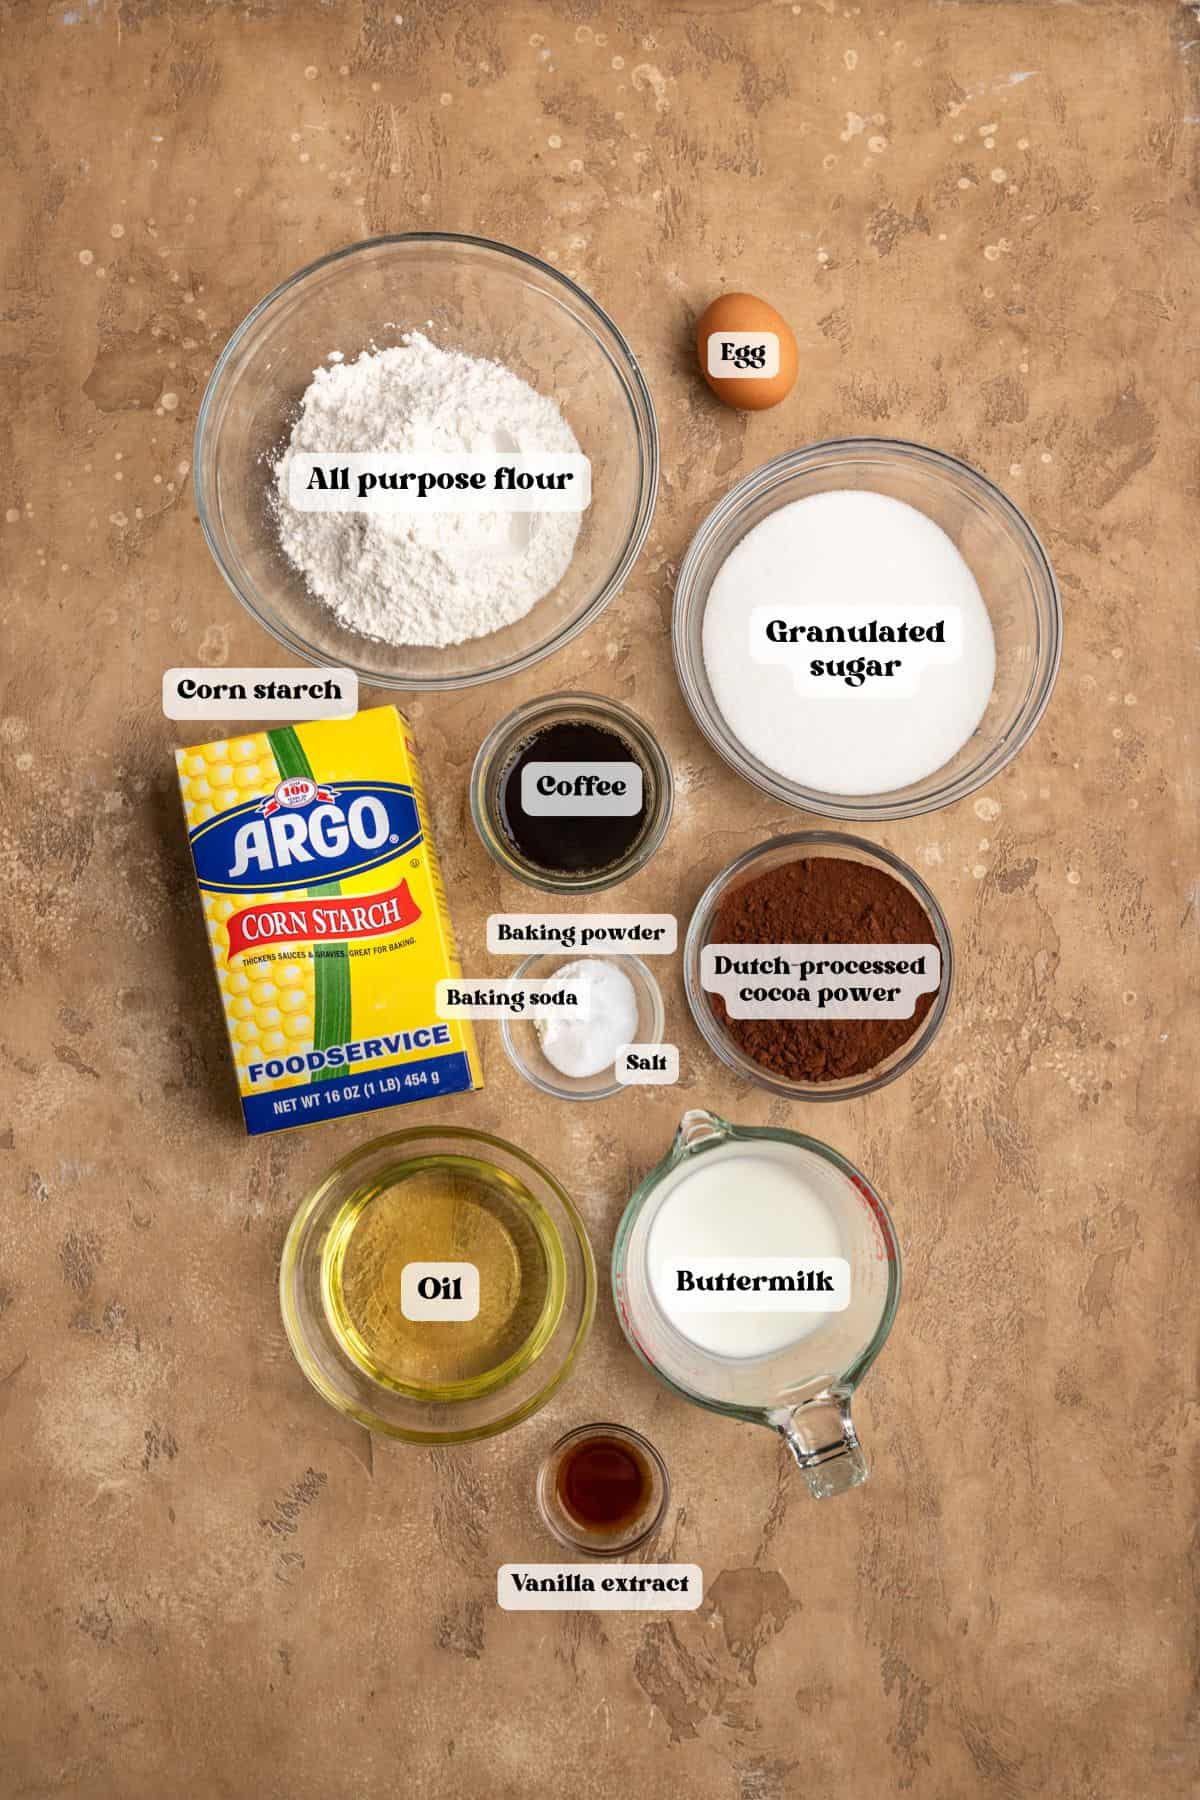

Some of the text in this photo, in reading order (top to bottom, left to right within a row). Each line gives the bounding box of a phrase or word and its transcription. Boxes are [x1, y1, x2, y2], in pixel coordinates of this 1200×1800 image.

[283, 783, 309, 797] 100
[228, 796, 390, 878] ARGO
[241, 909, 308, 941] CORN
[312, 898, 401, 934] STARCH
[278, 951, 306, 961] SAUCES
[374, 945, 387, 955] FOR
[248, 1024, 451, 1083] FOODSERVICE
[273, 1071, 440, 1115] NET WT 16 OZ (1 LB) 454 g
